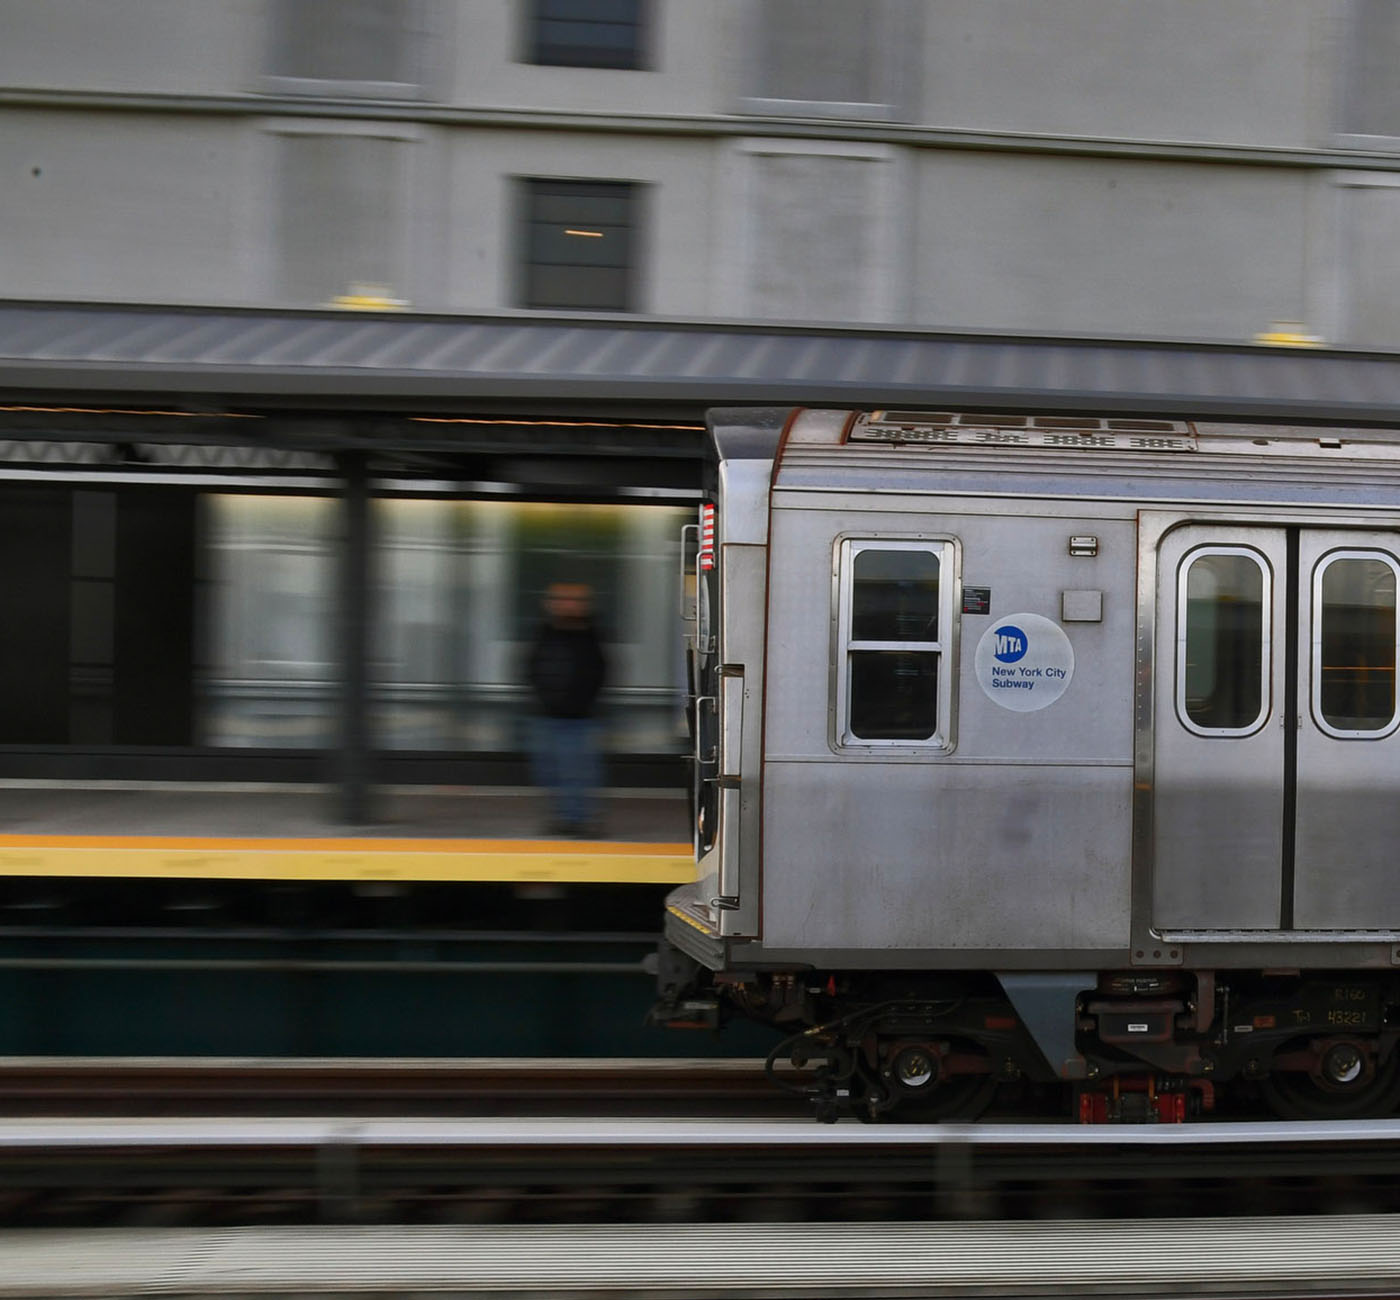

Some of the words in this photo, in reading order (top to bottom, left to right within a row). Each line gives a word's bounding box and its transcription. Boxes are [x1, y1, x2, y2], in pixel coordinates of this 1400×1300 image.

[994, 634, 1021, 655] MTA
[992, 667, 1015, 676] New
[1019, 667, 1042, 677] York
[1046, 668, 1067, 679] City
[992, 679, 1034, 690] Subway
